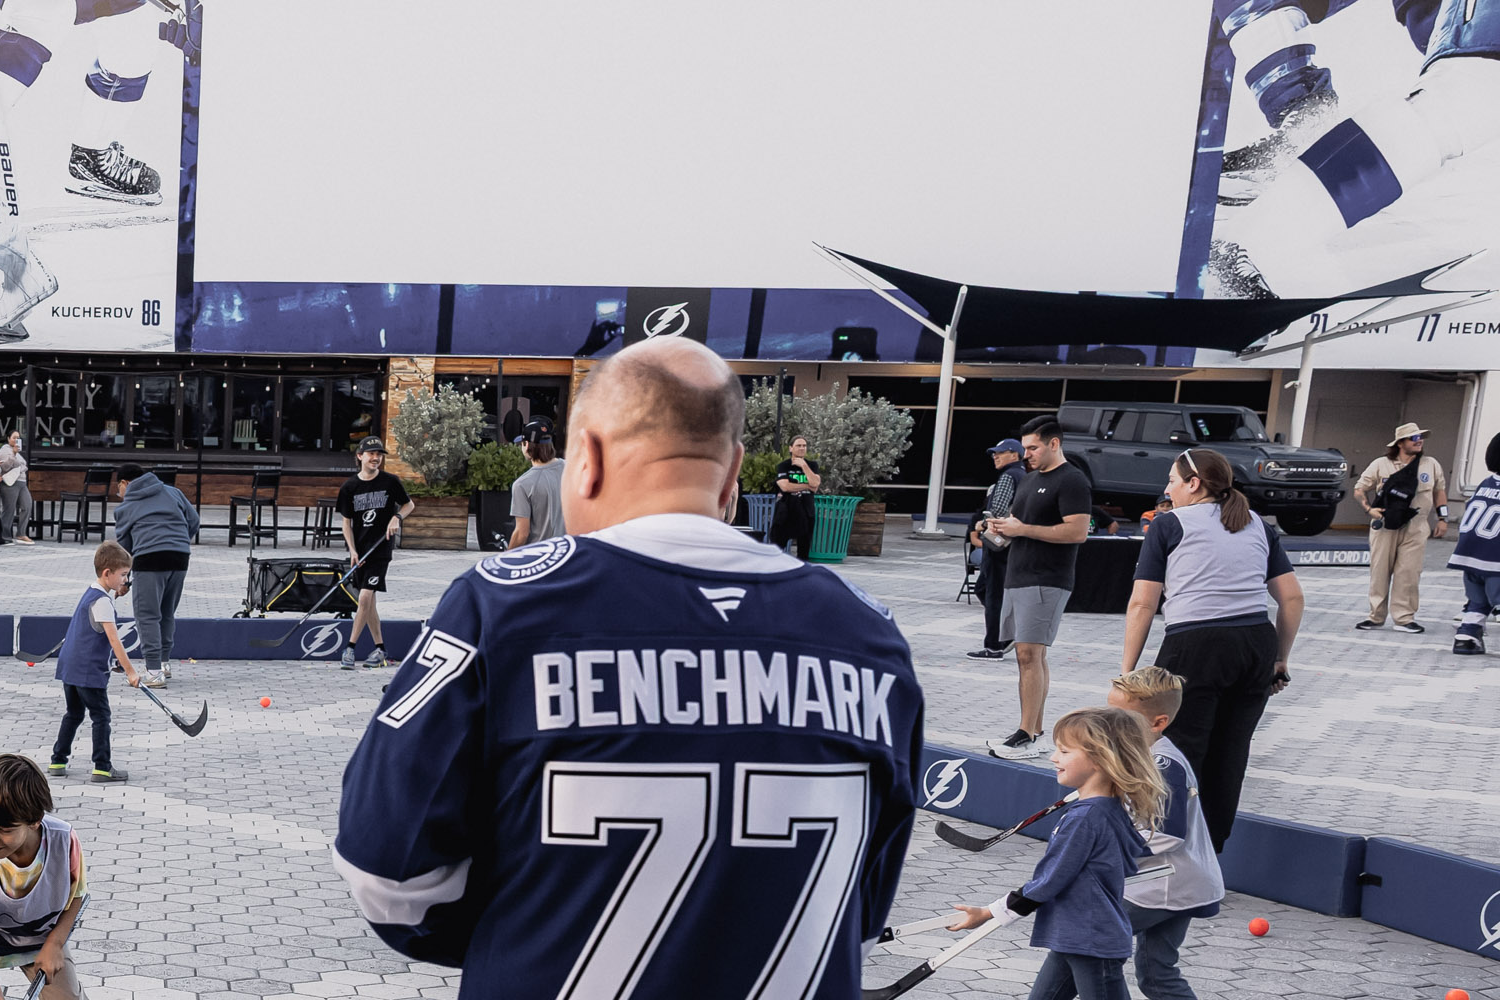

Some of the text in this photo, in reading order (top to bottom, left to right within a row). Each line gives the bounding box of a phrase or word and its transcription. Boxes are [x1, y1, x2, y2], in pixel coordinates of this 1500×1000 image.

[51, 299, 161, 326] KUCHEROV 86
[1416, 313, 1441, 342] 77
[20, 382, 103, 410] CITY
[1299, 550, 1330, 563] LOCAL
[1332, 550, 1360, 563] FORD
[377, 626, 478, 729] 7
[533, 649, 897, 747] BENCHMARK
